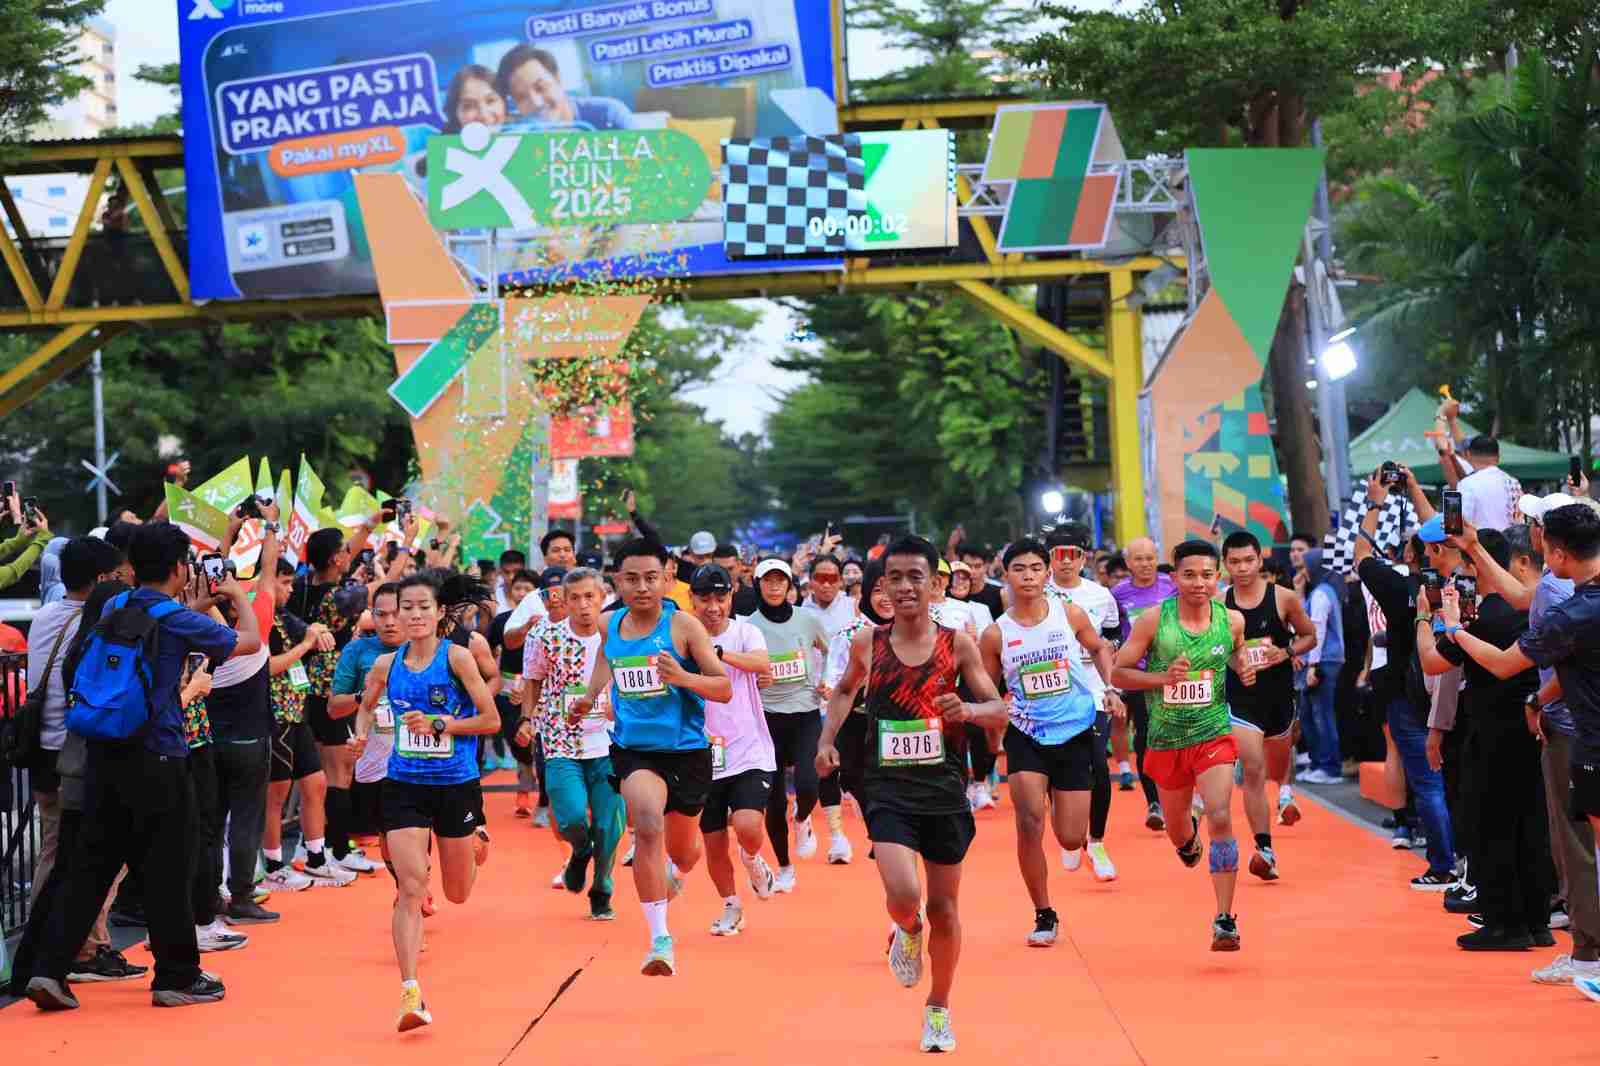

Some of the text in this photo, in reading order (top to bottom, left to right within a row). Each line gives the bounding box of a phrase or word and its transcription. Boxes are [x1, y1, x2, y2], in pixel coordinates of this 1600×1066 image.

[533, 0, 712, 36] Pasti Banyak Bonus
[595, 23, 749, 59] Pasti Lebih Murah
[653, 47, 787, 81] Praktis Dipakai
[228, 64, 424, 115] YANG PASTI
[231, 93, 431, 143] PRAKTIS AJA
[281, 135, 398, 167] Pakai myXL
[549, 136, 654, 161] KALLA
[549, 160, 613, 187] RUN
[549, 186, 632, 218] 2025
[809, 214, 908, 236] 00:00:02
[622, 669, 653, 689] 1884
[1031, 672, 1061, 690] 2165
[1171, 683, 1204, 700] 2005
[892, 735, 931, 756] 2876
